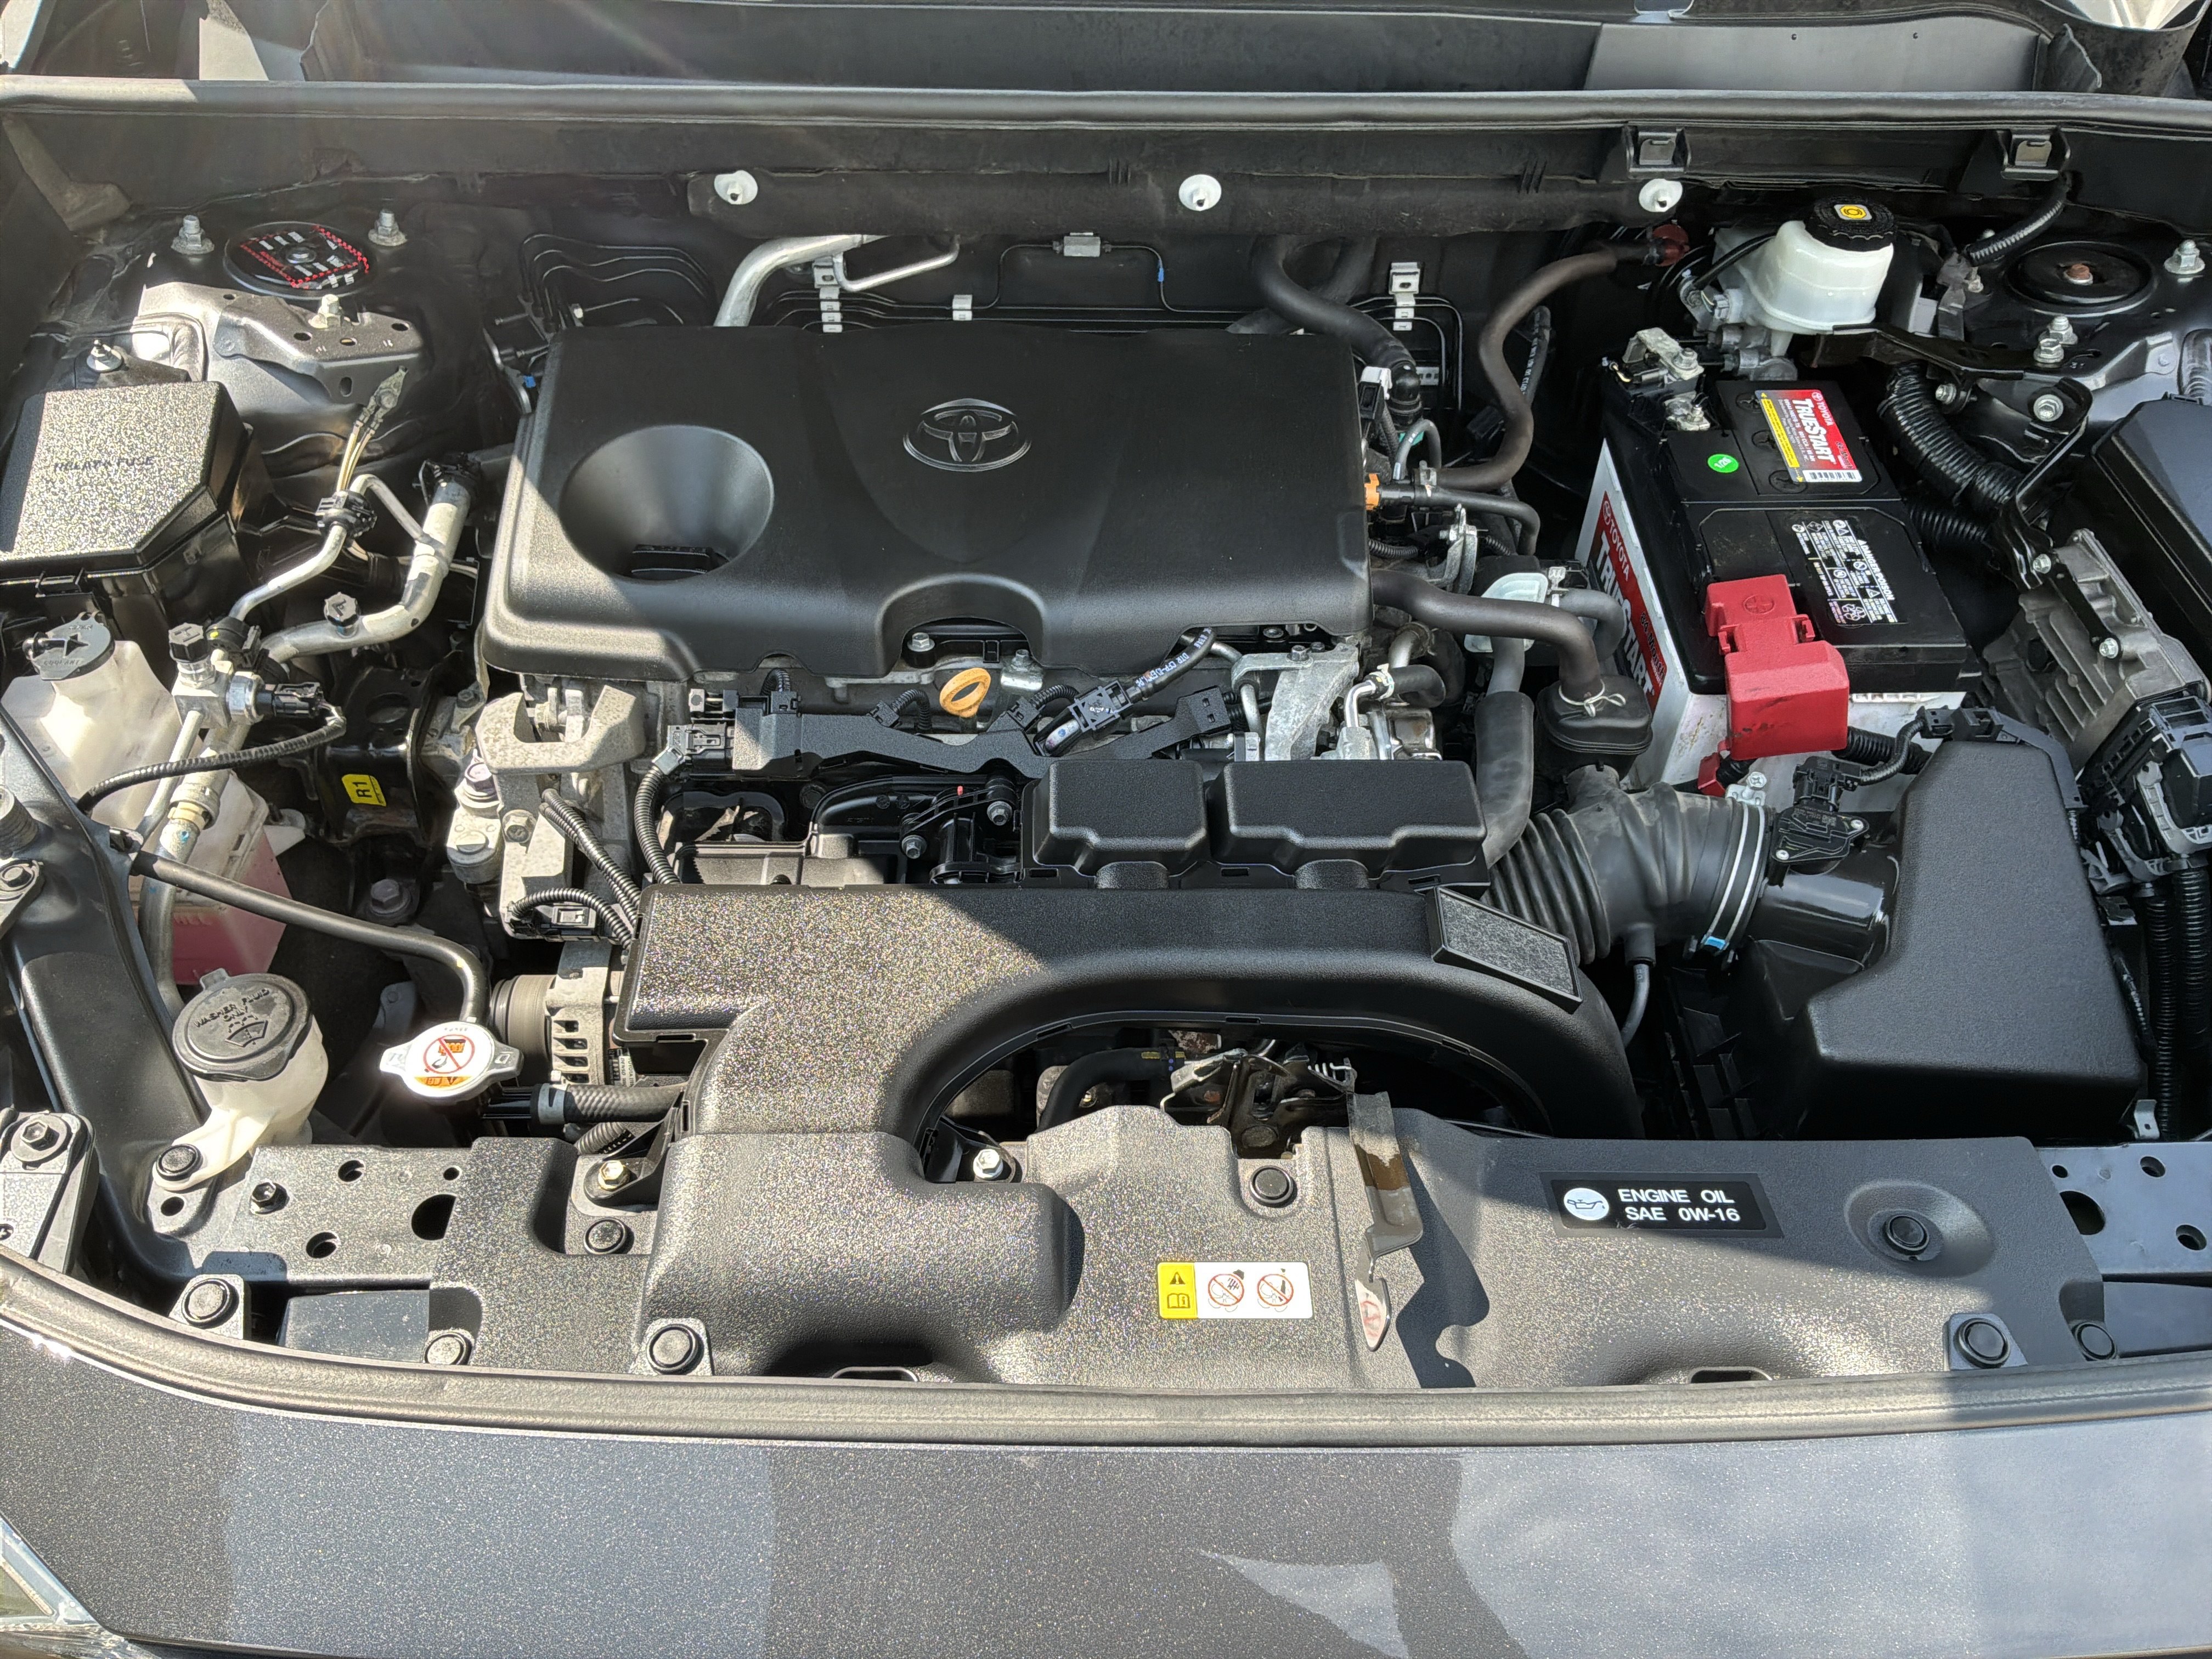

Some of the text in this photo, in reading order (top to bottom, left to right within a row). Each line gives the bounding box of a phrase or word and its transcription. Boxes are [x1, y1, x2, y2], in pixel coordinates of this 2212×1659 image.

[1816, 401, 1833, 426] TOYOTA
[1609, 518, 1629, 582] TOYOTA
[1860, 544, 1895, 600] DANGER/POISON
[1647, 633, 1665, 680] Month
[352, 782, 372, 798] R1
[194, 988, 270, 1028] WASHER FLUID
[223, 1006, 248, 1022] ONLY
[1618, 1189, 1736, 1204] ENGINE OIL
[1625, 1206, 1741, 1221] SAE 0W-16
